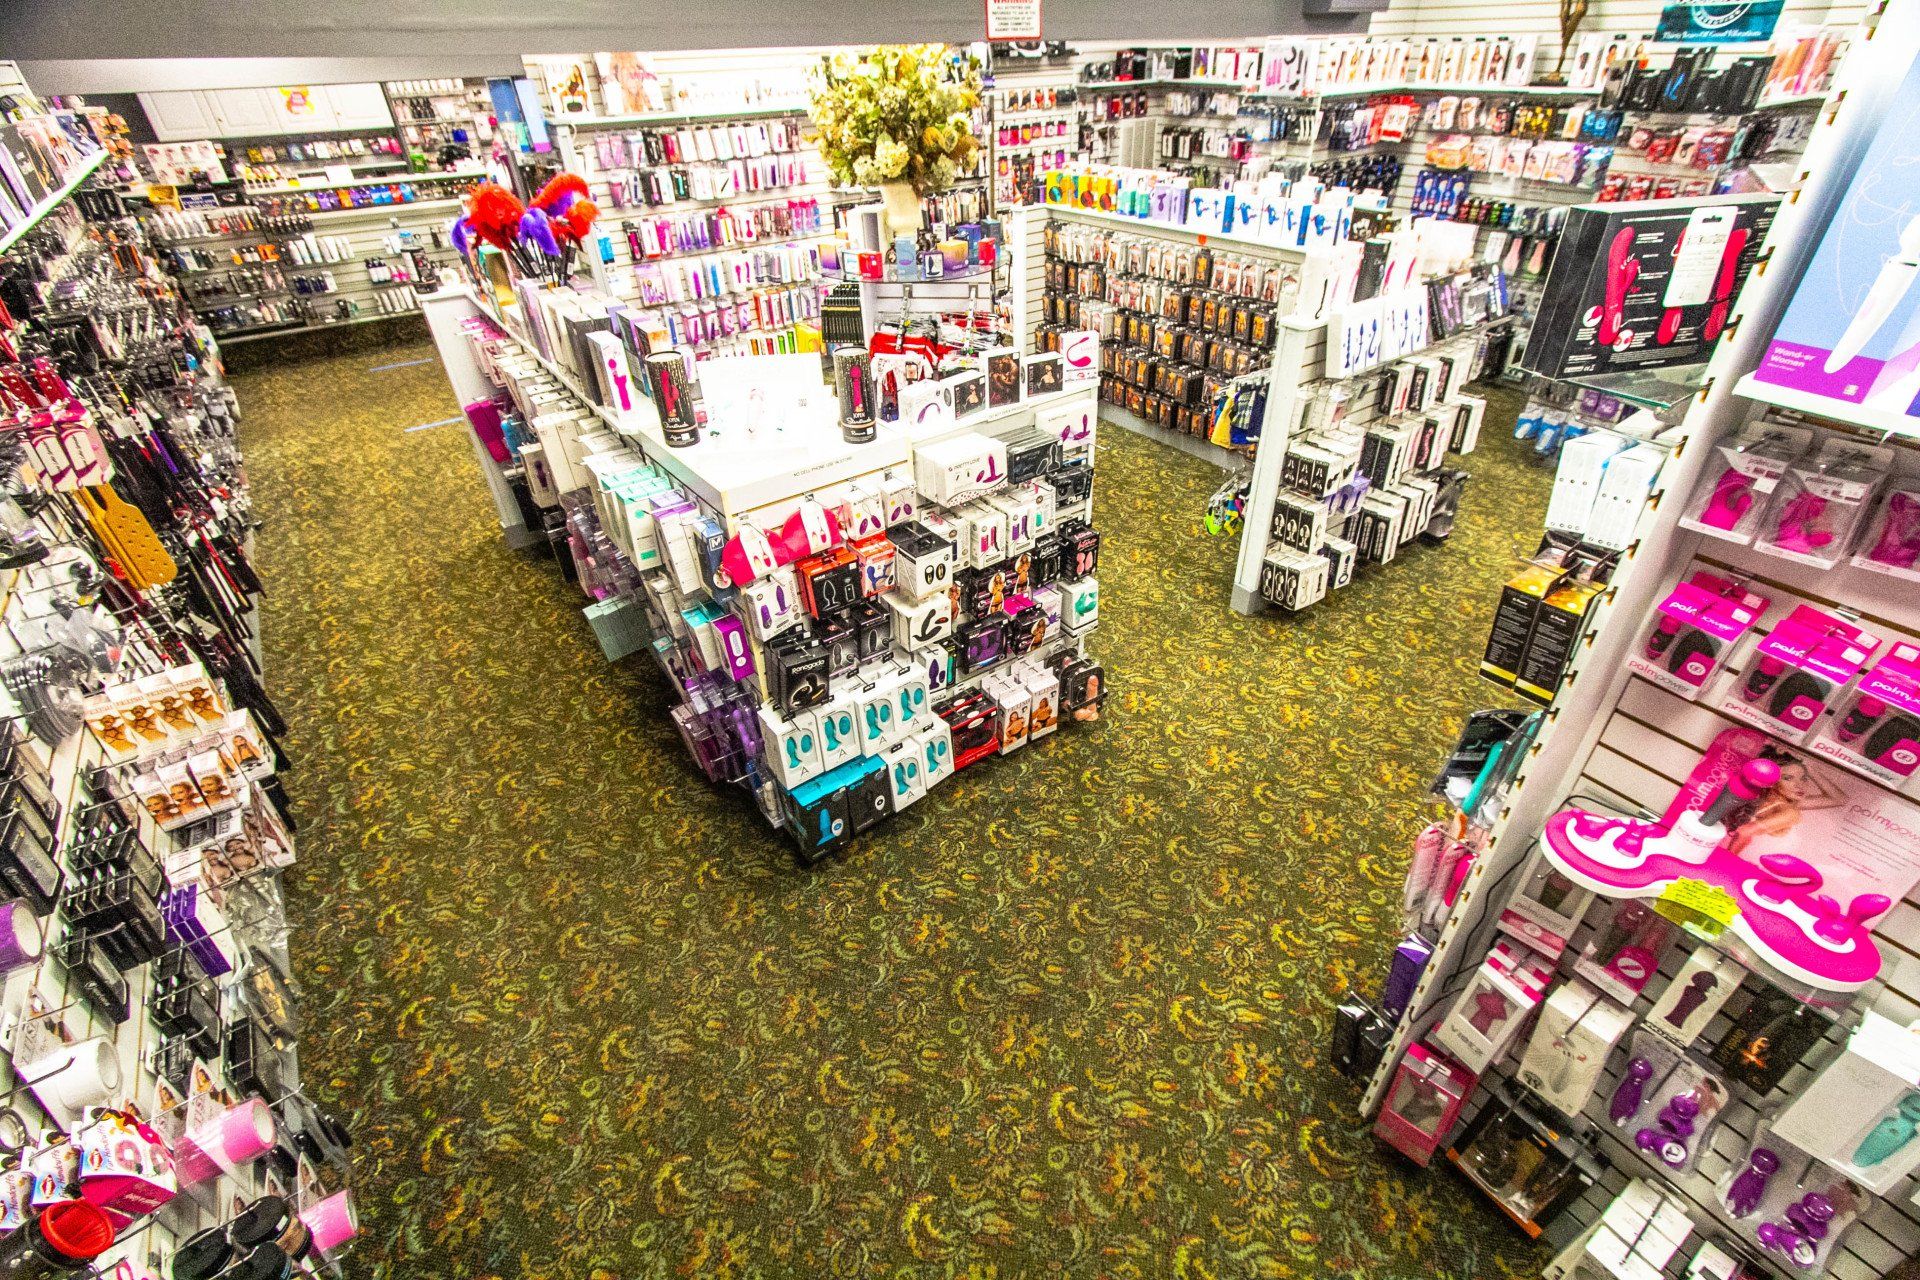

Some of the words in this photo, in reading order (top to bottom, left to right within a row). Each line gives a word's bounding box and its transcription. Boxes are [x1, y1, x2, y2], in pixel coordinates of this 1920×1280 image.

[711, 537, 722, 548] M
[1628, 659, 1690, 692] palmpower
[1725, 701, 1796, 738] palmpower
[1814, 741, 1894, 782] palmpower
[5, 1173, 19, 1209] Handcuffs
